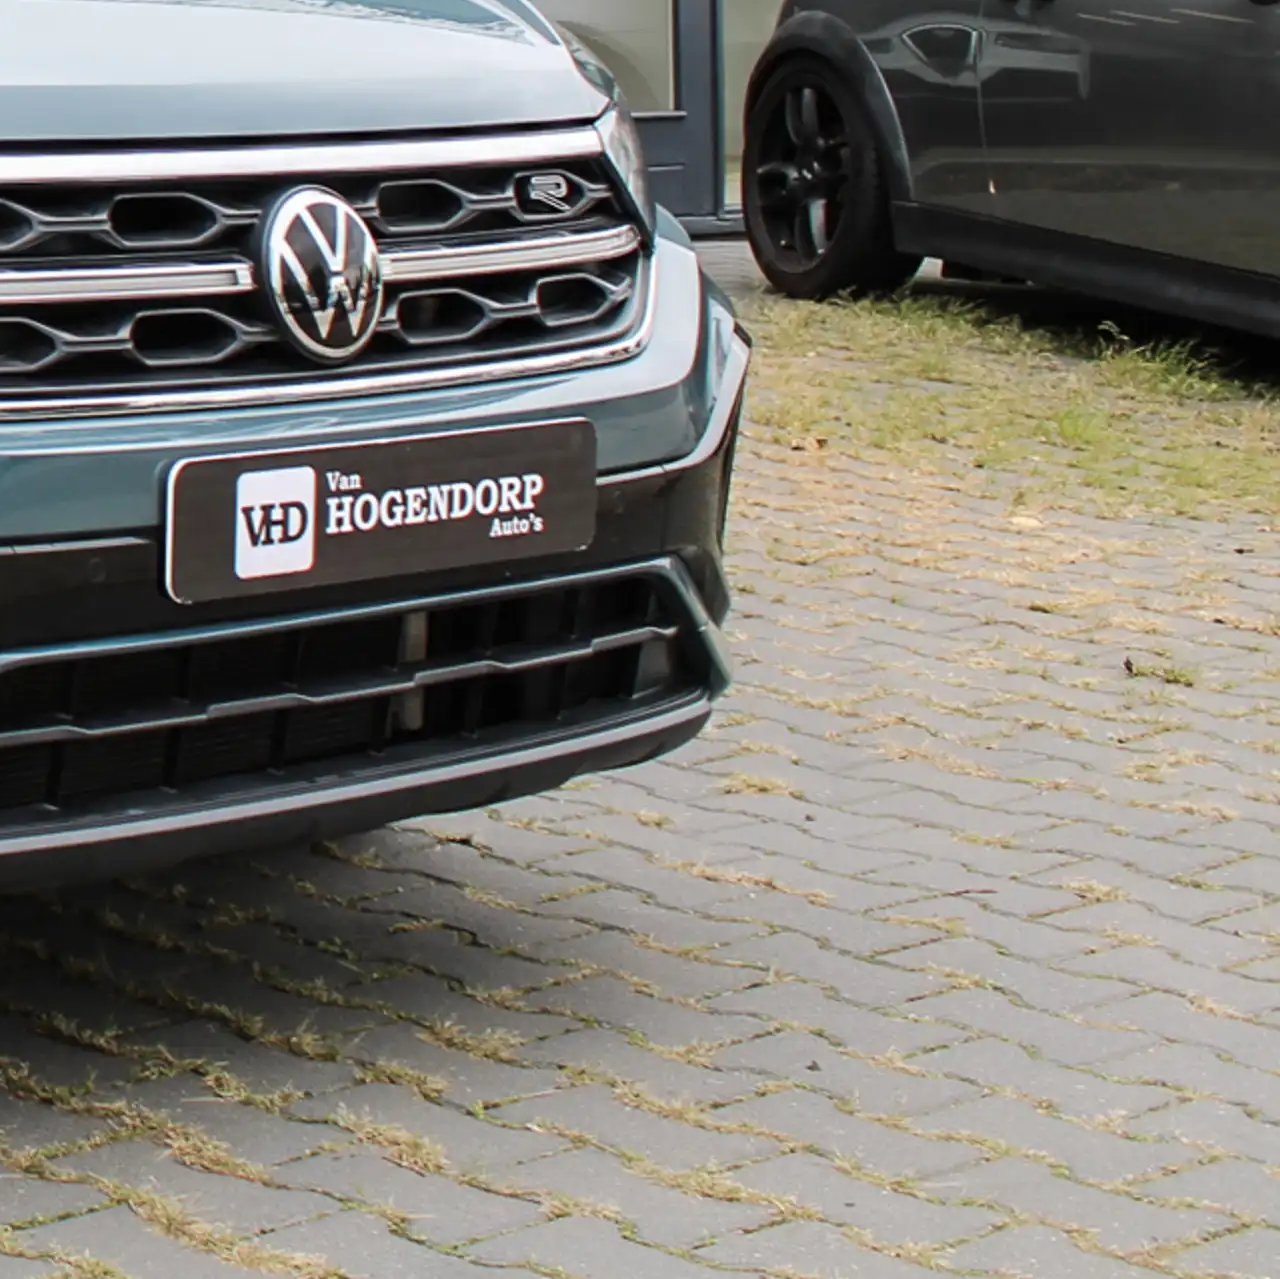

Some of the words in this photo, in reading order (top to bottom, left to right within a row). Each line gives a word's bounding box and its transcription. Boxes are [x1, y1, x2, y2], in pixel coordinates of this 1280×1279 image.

[326, 472, 362, 492] Van
[325, 474, 544, 535] HOGENDORP
[240, 500, 309, 547] VHD
[489, 513, 544, 538] Auto's
